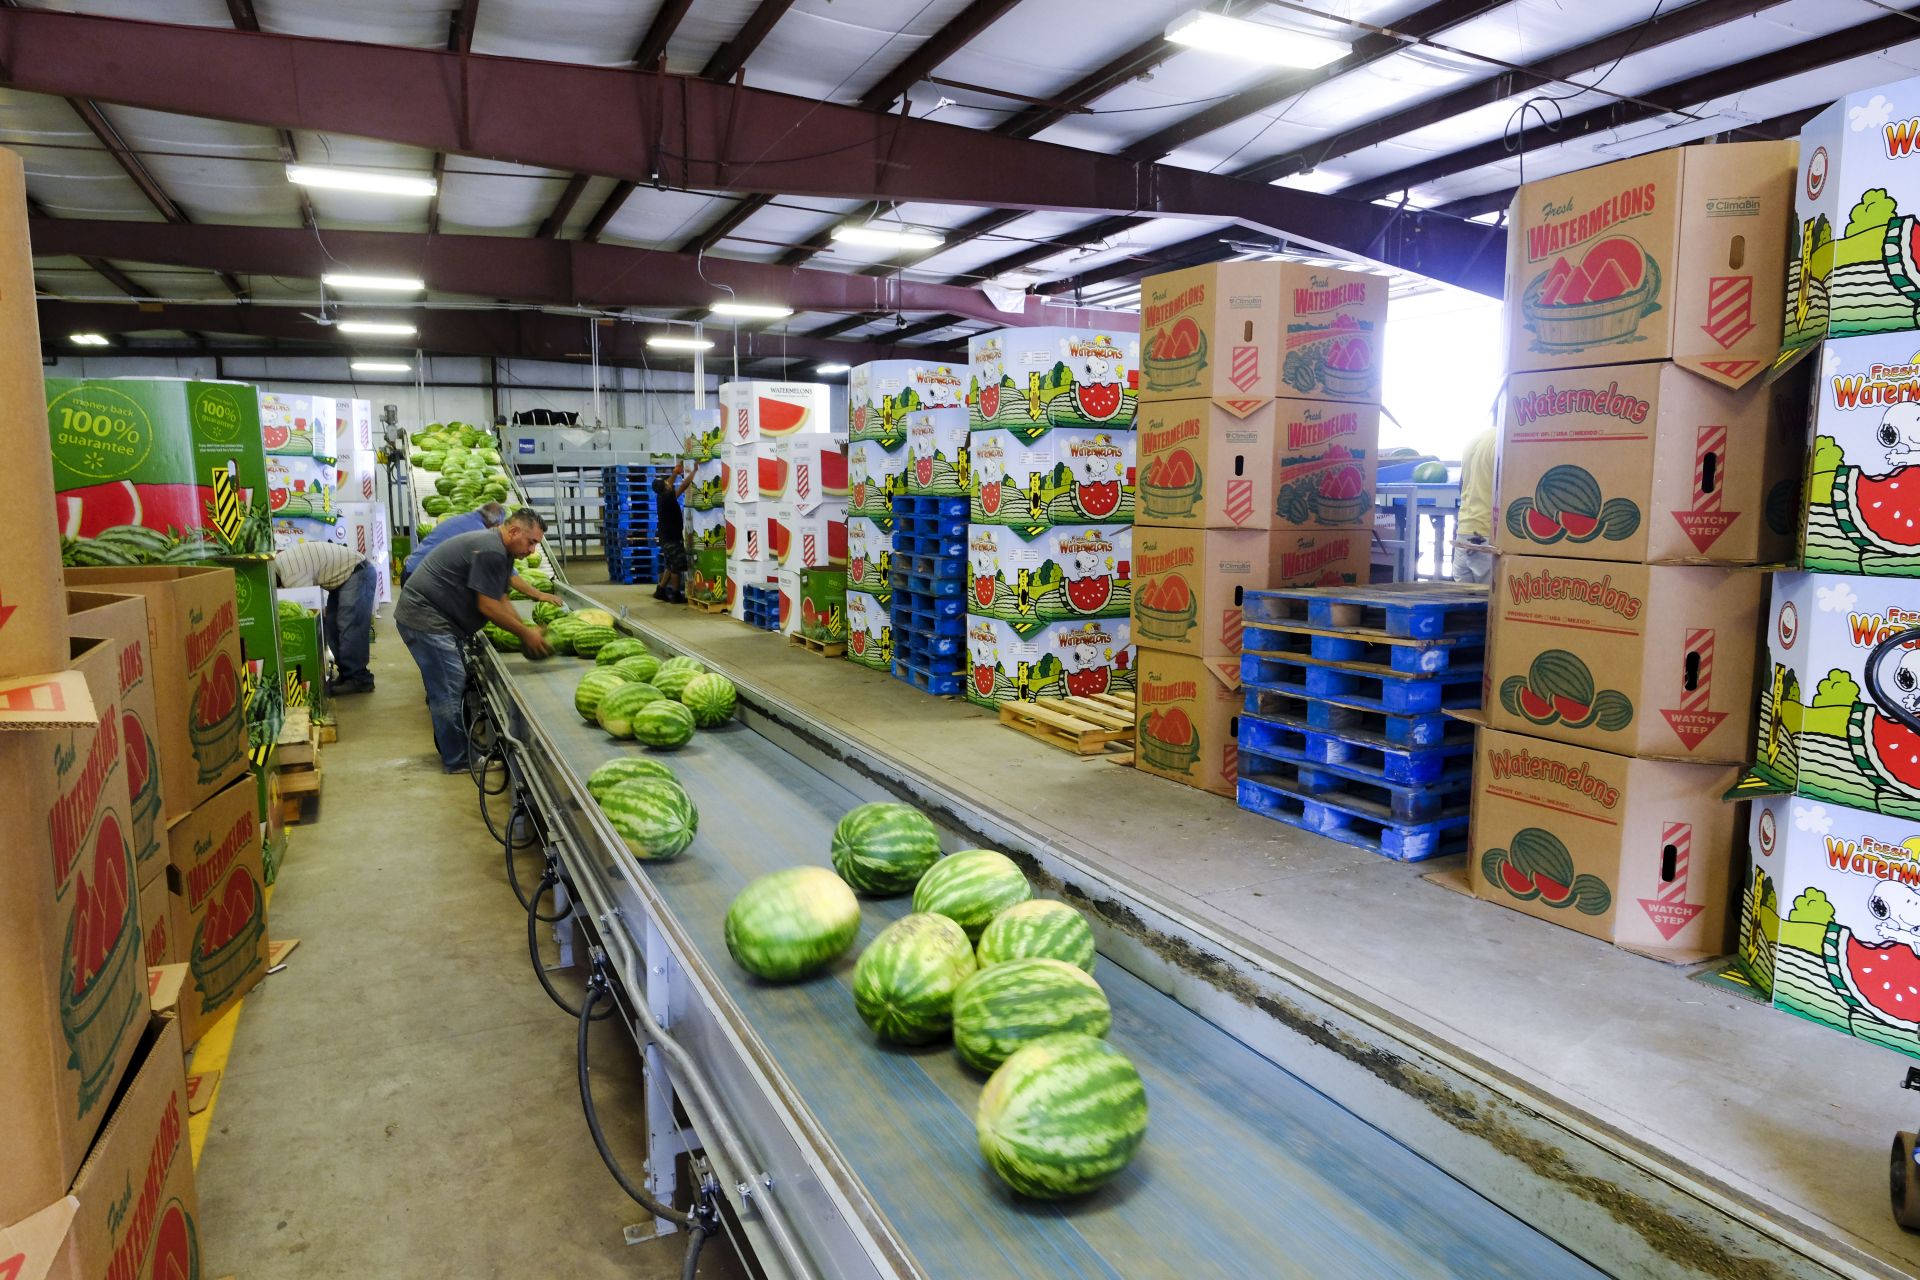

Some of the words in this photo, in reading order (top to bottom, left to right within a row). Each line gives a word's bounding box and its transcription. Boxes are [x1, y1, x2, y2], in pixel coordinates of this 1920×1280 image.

[1541, 197, 1575, 221] Fresh
[1529, 183, 1656, 261] WATERMELONS
[1310, 275, 1329, 290] Fresh
[1145, 284, 1205, 328] WATERMELONS
[1294, 282, 1366, 316] WATERMELONS
[770, 387, 813, 395] WATERMELONS
[72, 398, 108, 412] money
[111, 405, 134, 417] back
[202, 400, 236, 422] 100%
[1512, 382, 1650, 426] Watermelons
[61, 407, 140, 444] 100%
[1303, 409, 1322, 422] Fresh
[1142, 418, 1200, 456] WATERMELONS
[1288, 413, 1358, 449] WATERMELONS
[58, 433, 135, 456] guarantee
[1683, 515, 1728, 526] WATCH
[1689, 527, 1721, 536] STEP
[1136, 547, 1194, 577] WATERMELONS
[1282, 539, 1350, 579] WATERMELONS
[1508, 570, 1642, 620] Watermelons
[1567, 617, 1591, 625] MEXICO
[1888, 608, 1920, 624] FRE
[1142, 681, 1197, 702] WATERMELONS
[1671, 714, 1717, 725] WATCH
[1677, 725, 1709, 735] STEP
[1488, 748, 1621, 809] Watermelons
[187, 810, 253, 908] WATERMELONS
[1863, 838, 1910, 858] FRESH
[1648, 904, 1693, 916] WATCH
[1654, 915, 1686, 925] STEP
